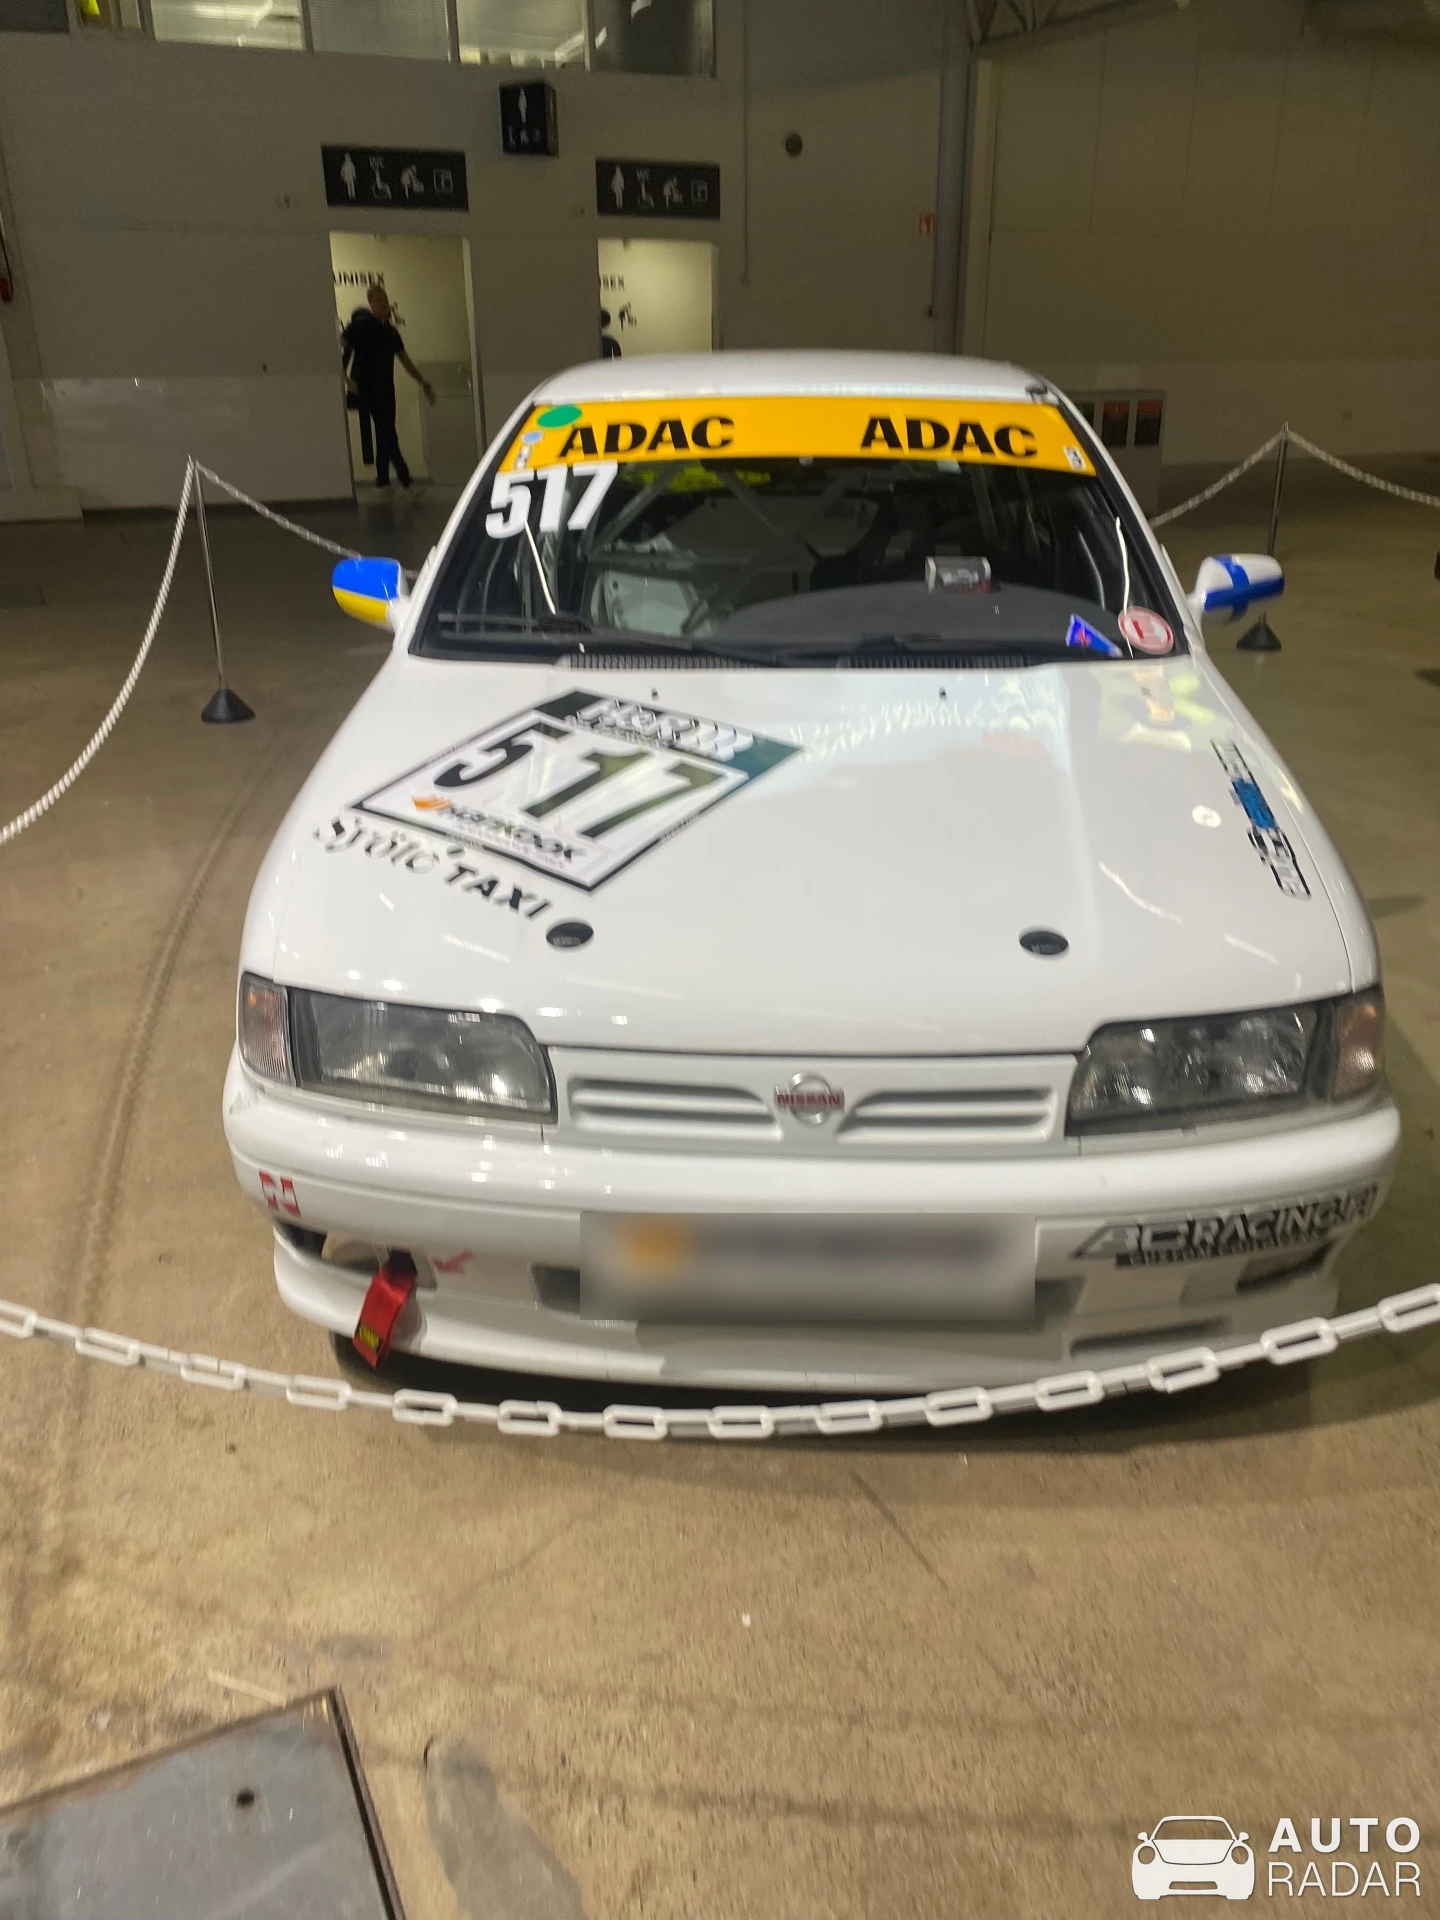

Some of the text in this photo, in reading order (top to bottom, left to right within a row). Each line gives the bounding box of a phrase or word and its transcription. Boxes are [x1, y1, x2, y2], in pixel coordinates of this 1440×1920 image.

[558, 415, 736, 457] ADAC
[860, 415, 1039, 459] ADAC
[486, 460, 618, 539] 517
[434, 723, 724, 838] 517
[443, 862, 553, 920] TAXI
[777, 1094, 841, 1106] NISSAN
